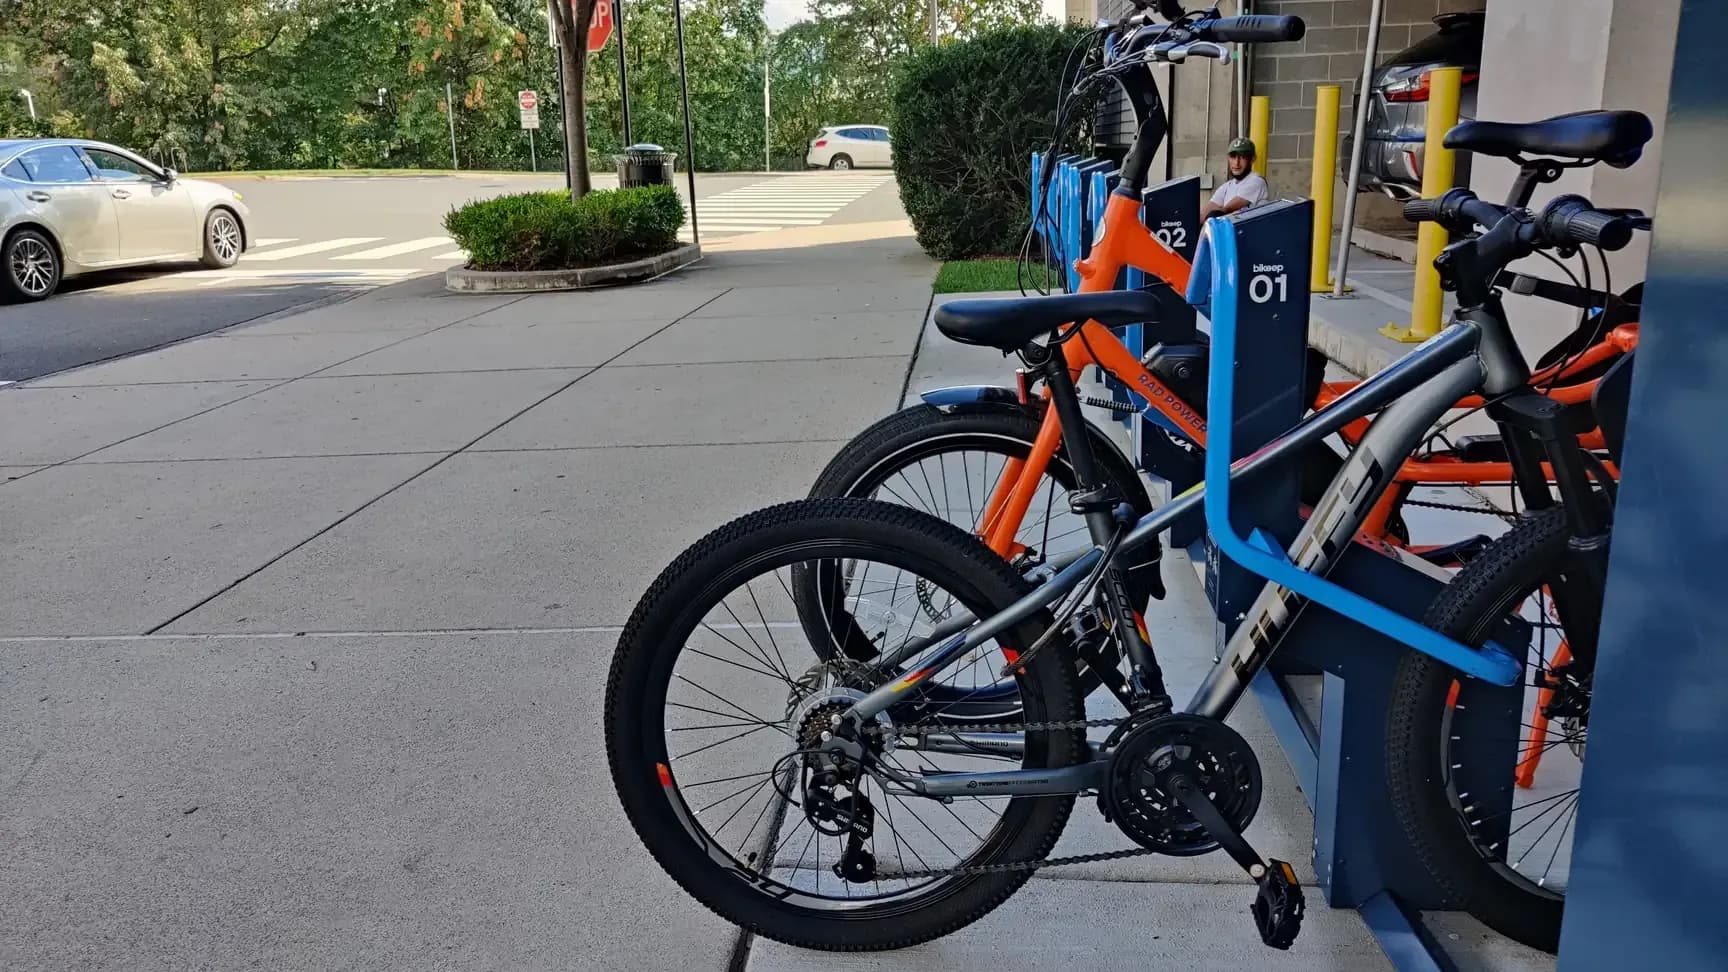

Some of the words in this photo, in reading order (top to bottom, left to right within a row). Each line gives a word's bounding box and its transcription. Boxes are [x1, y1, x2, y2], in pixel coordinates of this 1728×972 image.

[1253, 263, 1284, 273] bikeep
[1249, 273, 1287, 304] 01
[1138, 374, 1164, 397] RAD
[1165, 396, 1208, 433] POWER
